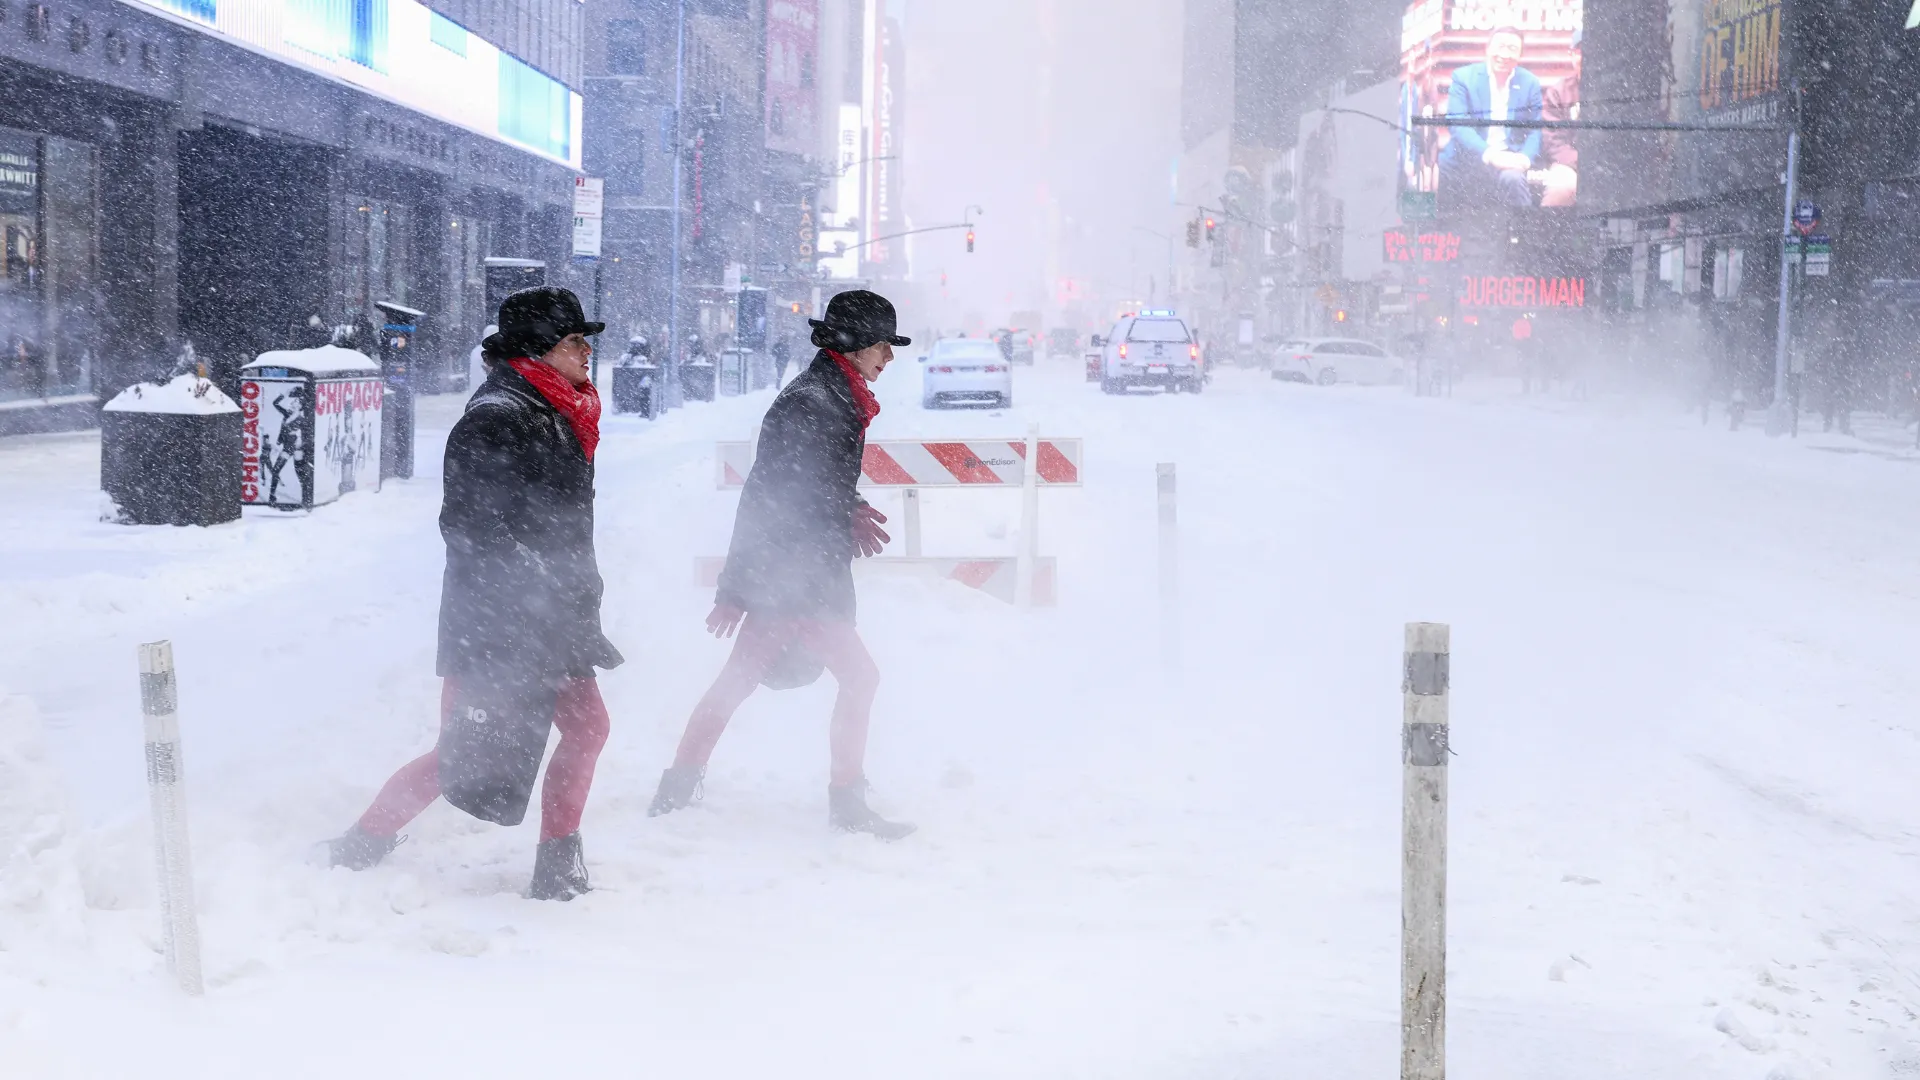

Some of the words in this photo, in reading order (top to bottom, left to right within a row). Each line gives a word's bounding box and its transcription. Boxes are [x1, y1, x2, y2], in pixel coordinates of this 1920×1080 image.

[1699, 26, 1730, 111] OF
[1732, 7, 1780, 103] HIM
[1539, 276, 1585, 308] MAN
[315, 381, 383, 416] CHICAGO
[241, 381, 260, 501] CHICAGO
